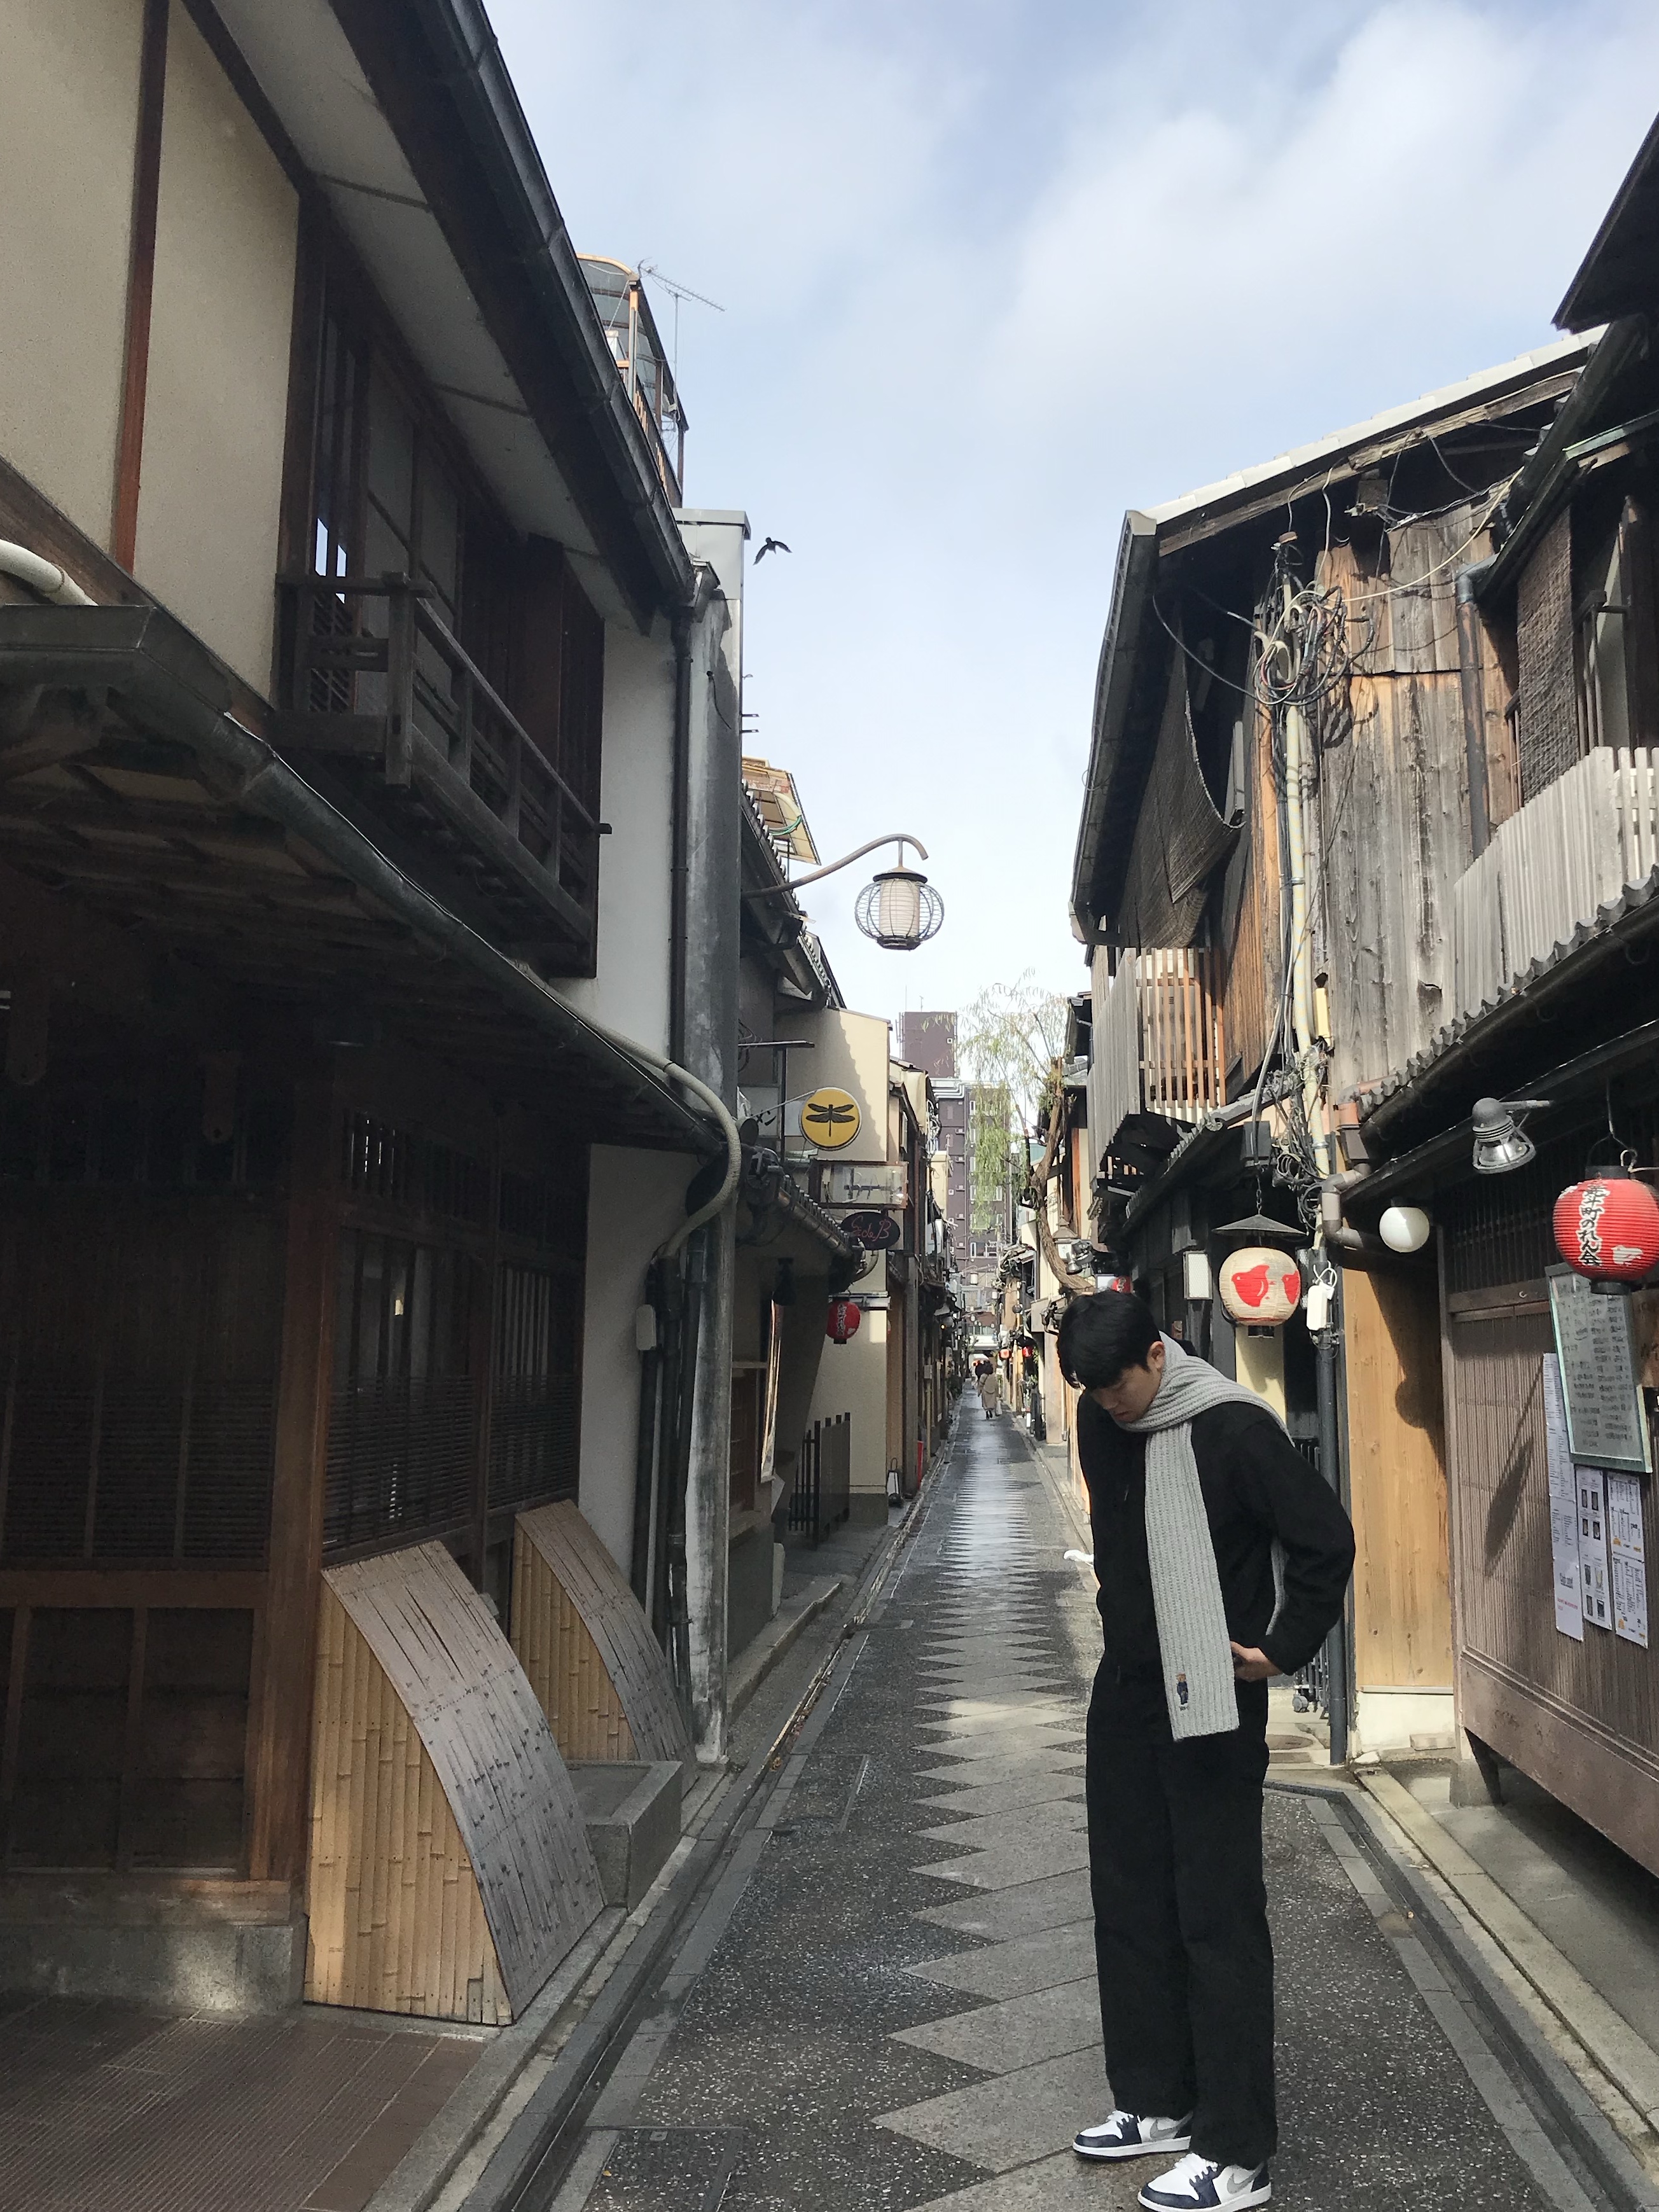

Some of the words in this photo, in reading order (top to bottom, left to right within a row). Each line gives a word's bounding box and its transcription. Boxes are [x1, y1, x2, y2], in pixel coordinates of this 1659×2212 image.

[871, 1218, 892, 1242] B
[1577, 1183, 1607, 1267] 先斗町のれん会
